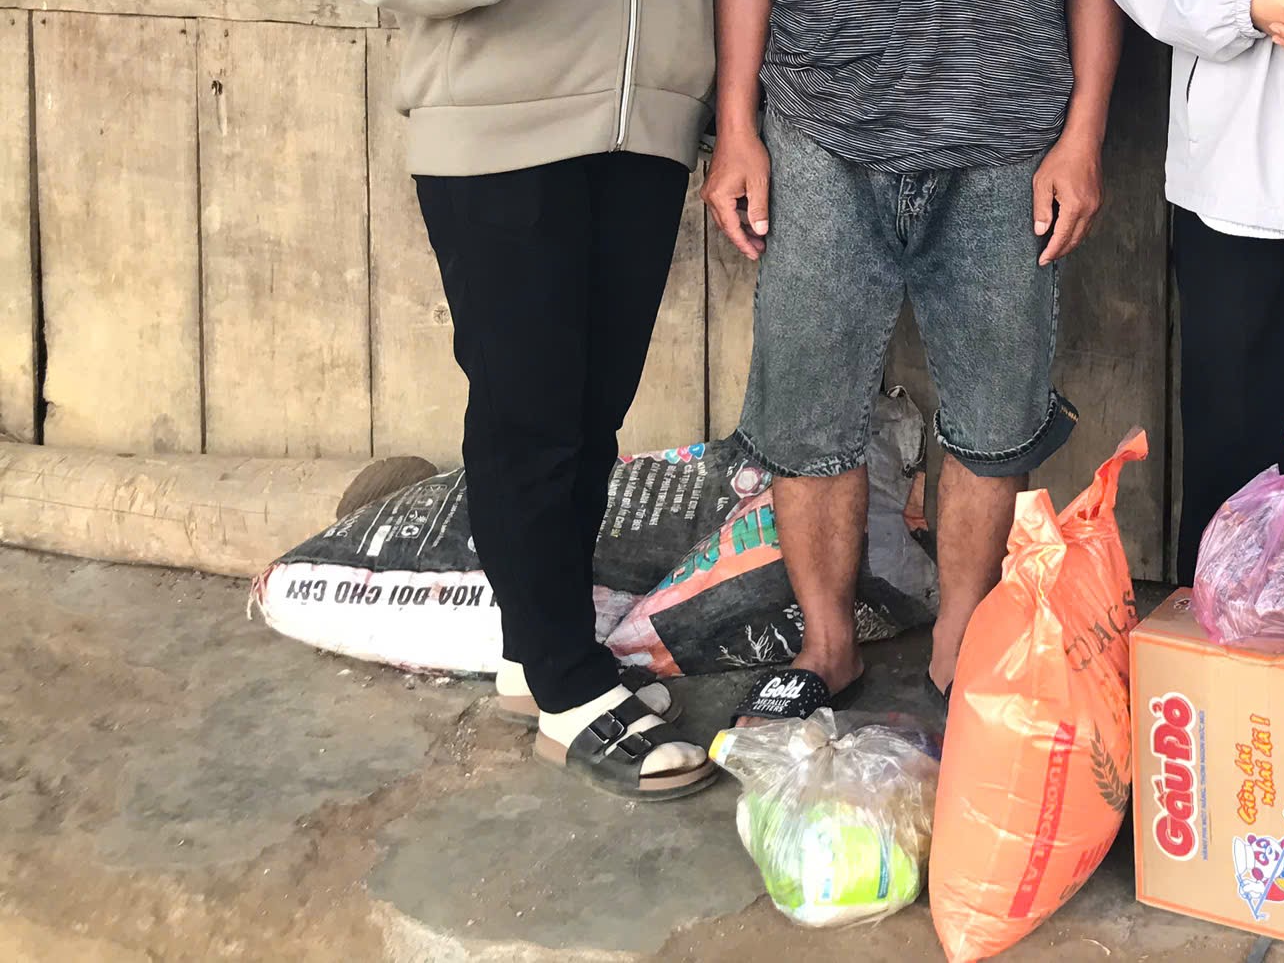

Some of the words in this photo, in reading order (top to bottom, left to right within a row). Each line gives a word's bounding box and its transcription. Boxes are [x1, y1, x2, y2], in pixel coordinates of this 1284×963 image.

[759, 676, 806, 700] Gold
[752, 697, 791, 707] METALLIC
[752, 704, 785, 713] LETTERS
